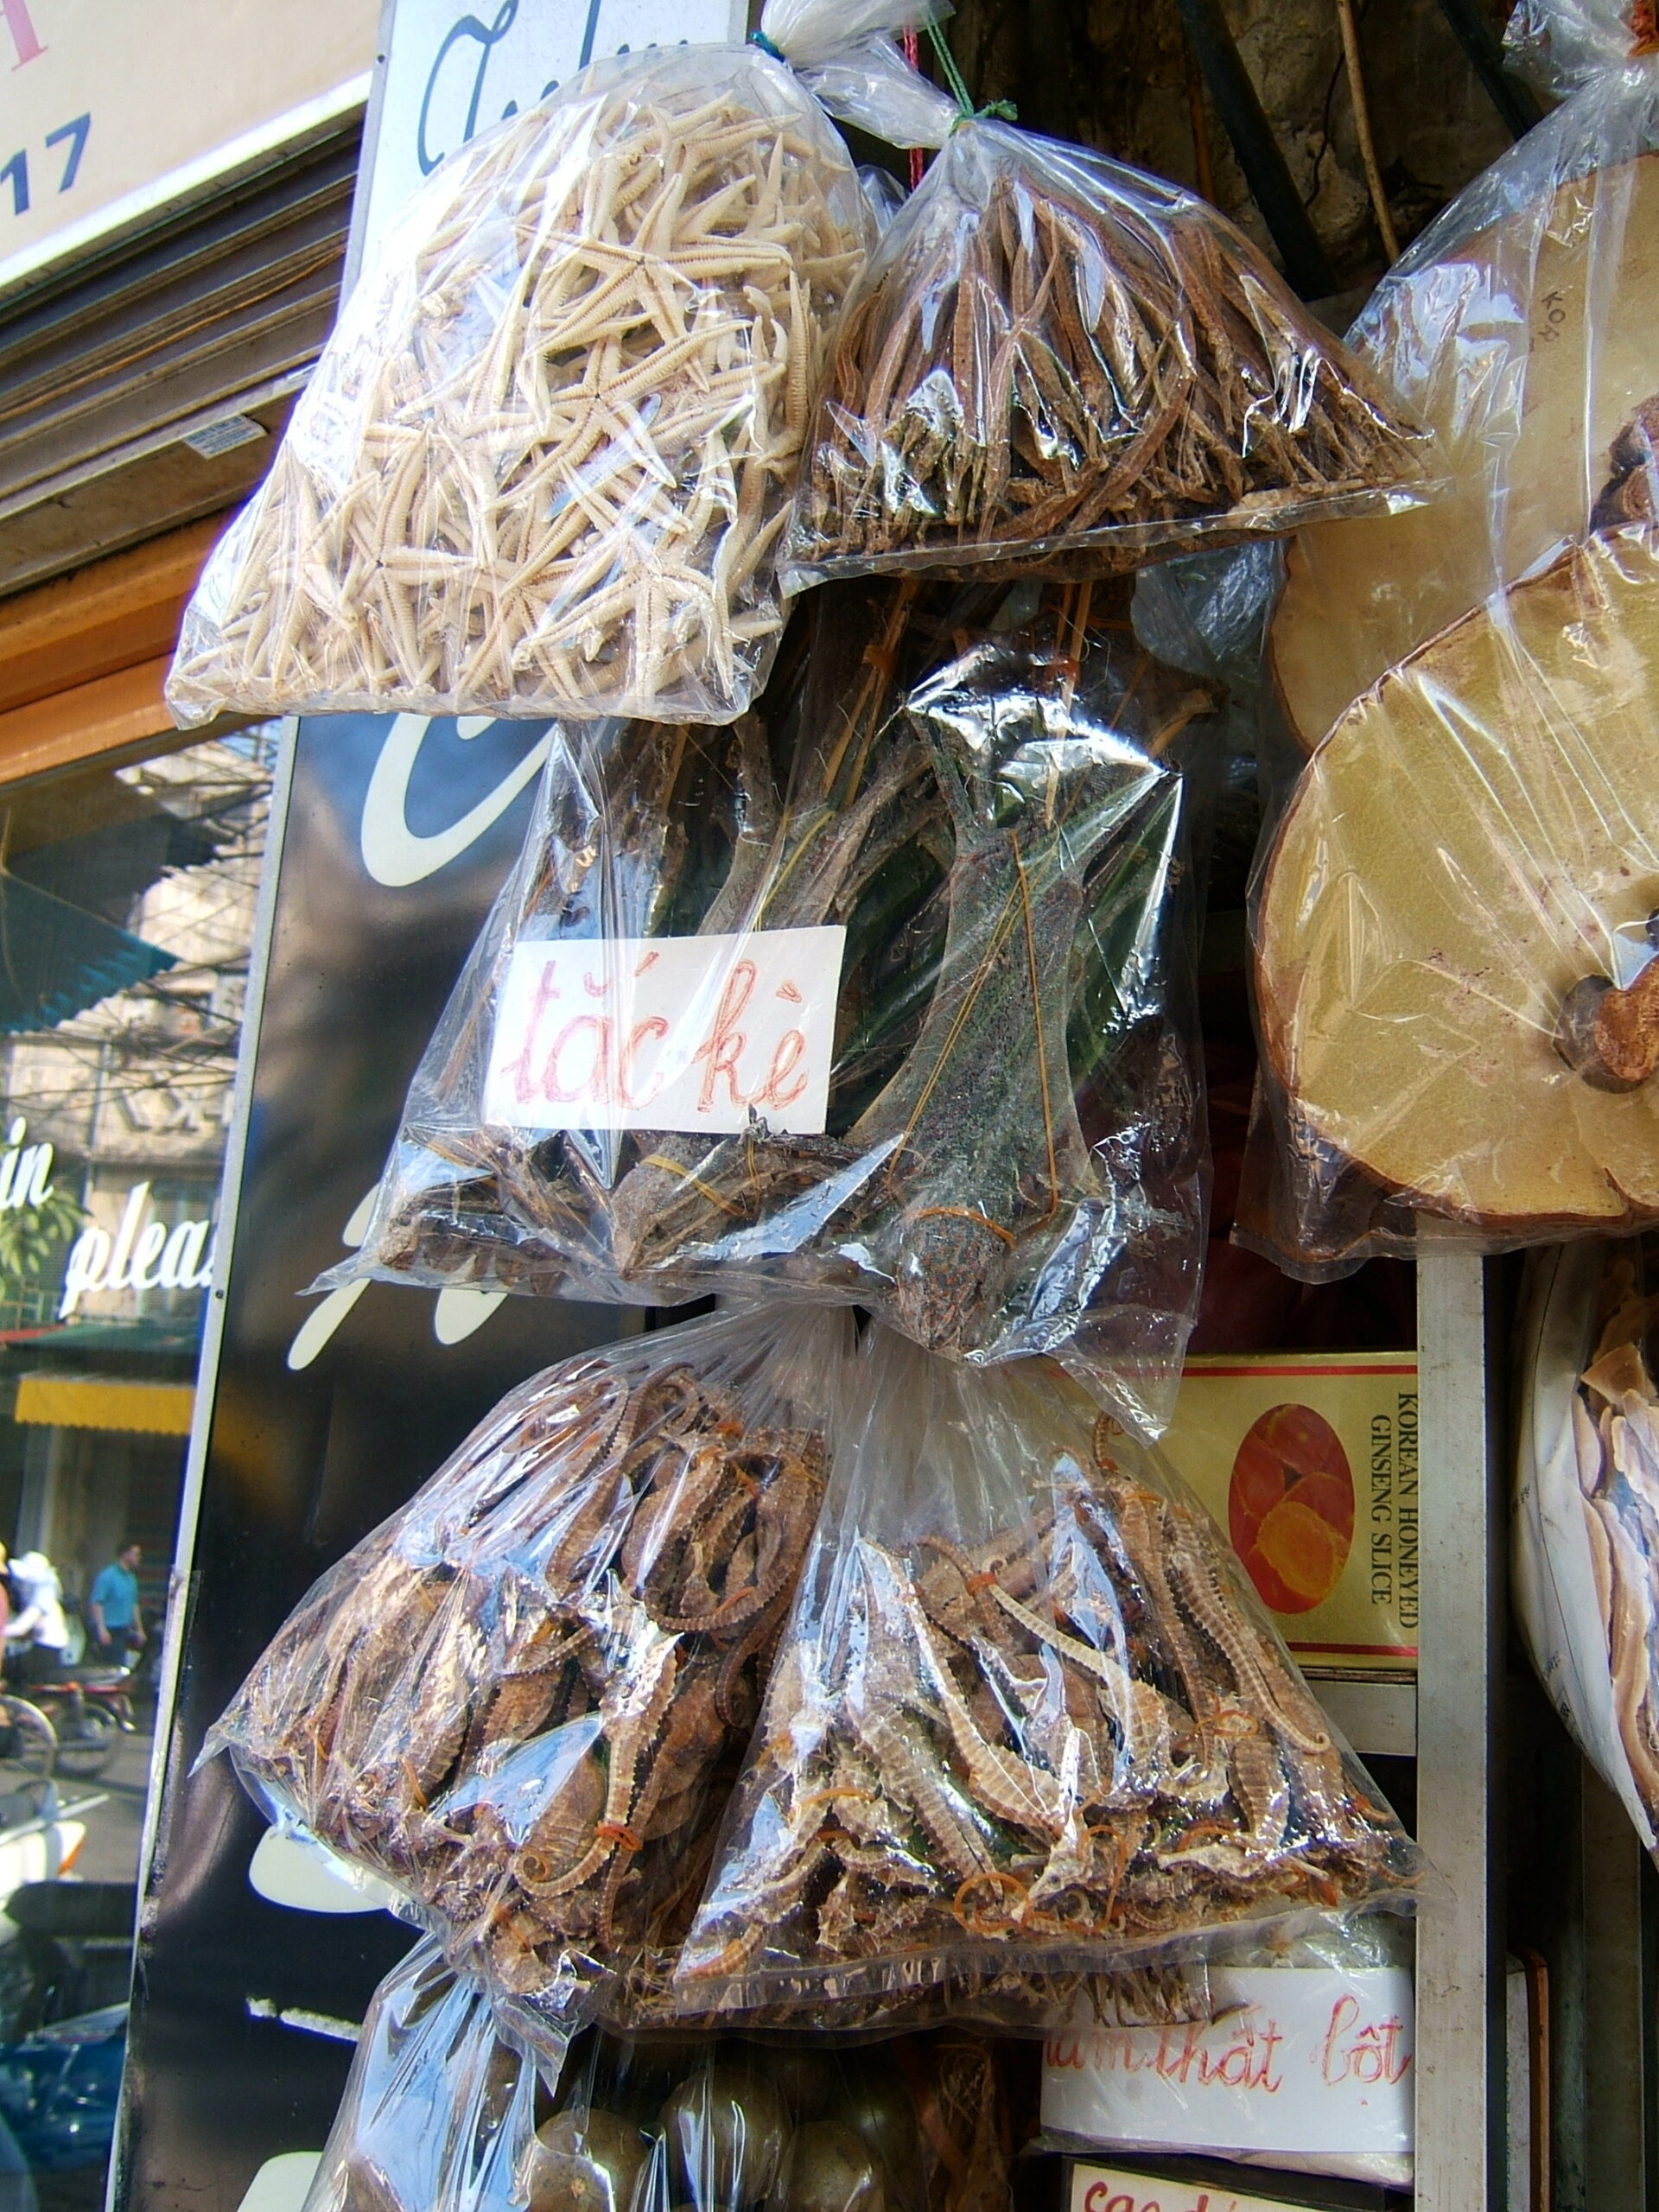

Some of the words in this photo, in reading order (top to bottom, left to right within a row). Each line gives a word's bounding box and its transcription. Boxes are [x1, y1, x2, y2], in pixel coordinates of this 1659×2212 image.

[0, 111, 92, 215] 17
[500, 951, 669, 1110] tắc
[692, 959, 809, 1113] kè
[1370, 1414, 1392, 1522] GINSENG
[1398, 1392, 1418, 1496] KOREAN
[1370, 1533, 1392, 1605] SLICE
[1398, 1506, 1418, 1629] HONEYED
